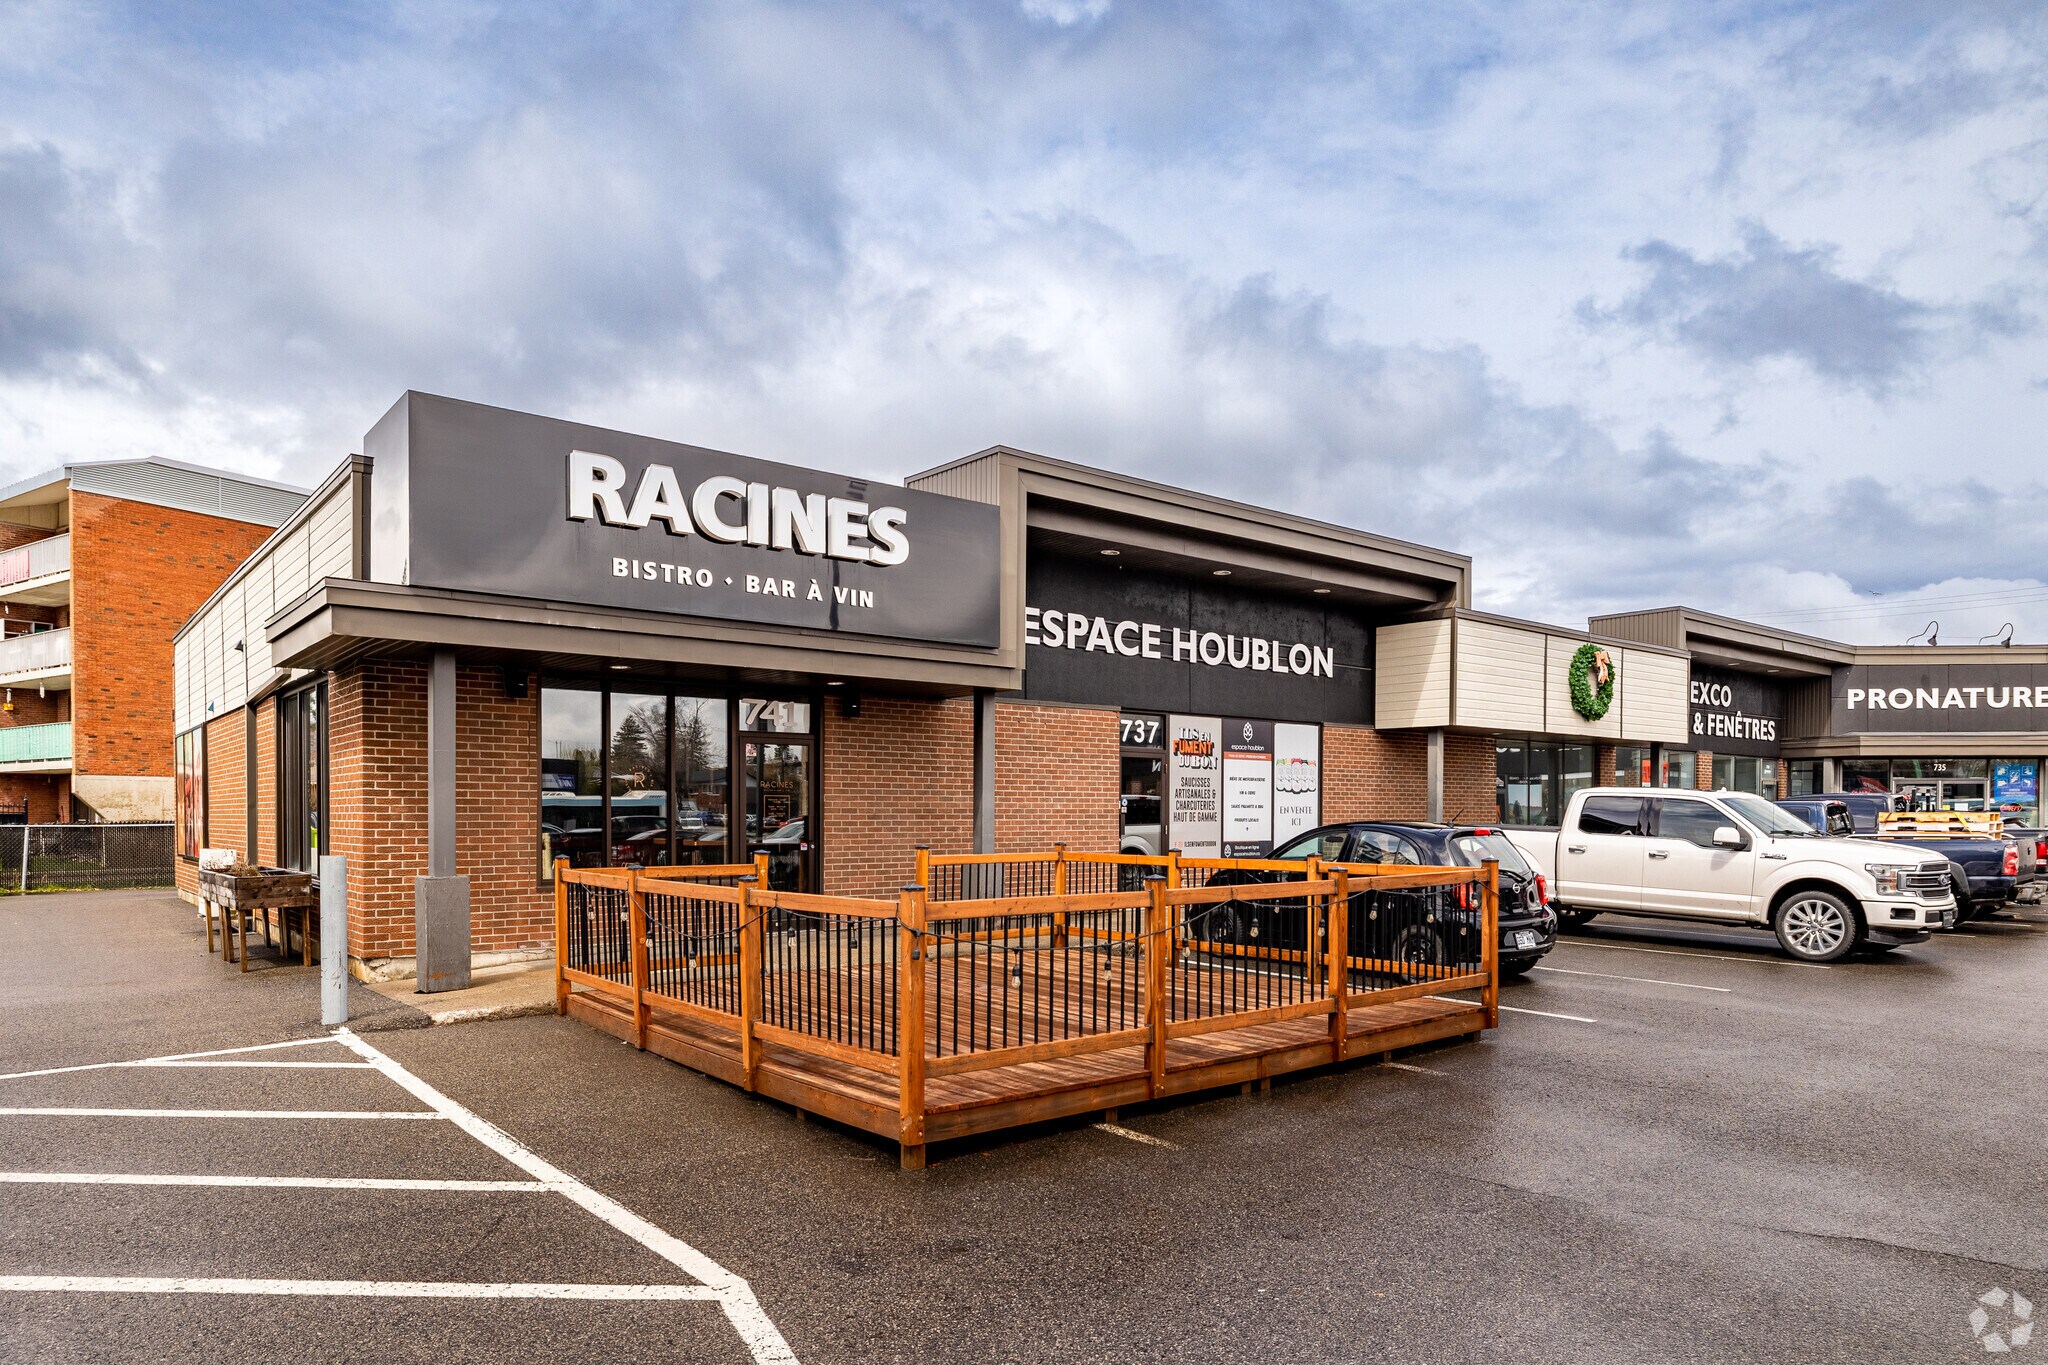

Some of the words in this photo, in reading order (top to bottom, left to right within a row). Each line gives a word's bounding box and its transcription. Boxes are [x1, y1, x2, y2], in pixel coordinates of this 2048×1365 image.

[567, 450, 910, 566] RACINES
[612, 557, 713, 588] BISTRO
[745, 574, 796, 599] BAR
[806, 578, 823, 602] À
[834, 586, 874, 609] VIN
[1025, 606, 1161, 659] ESPACE
[1172, 627, 1334, 678] HOUBLON
[1690, 681, 1731, 707] EXCO
[1847, 686, 2048, 710] PRONATURE
[740, 698, 798, 728] 741
[1121, 719, 1159, 744] 737
[1179, 727, 1199, 741] ILS
[1200, 732, 1211, 742] EN
[1693, 712, 1704, 735] &
[1707, 711, 1776, 742] FENÊTRES
[1173, 740, 1214, 757] FUMENT
[1933, 763, 1946, 772] 735
[634, 771, 645, 788] R
[760, 780, 793, 789] RACINES
[1180, 776, 1211, 788] SAUCISSES
[1174, 788, 1212, 800] ARTISANALES
[1175, 800, 1216, 811] CHARCUTERIES
[1280, 805, 1290, 815] EN
[1289, 805, 1313, 815] VENTE
[1173, 811, 1187, 823] HAUT
[1189, 811, 1196, 823] DE
[1197, 811, 1218, 823] GAMME
[1292, 817, 1302, 827] ICI
